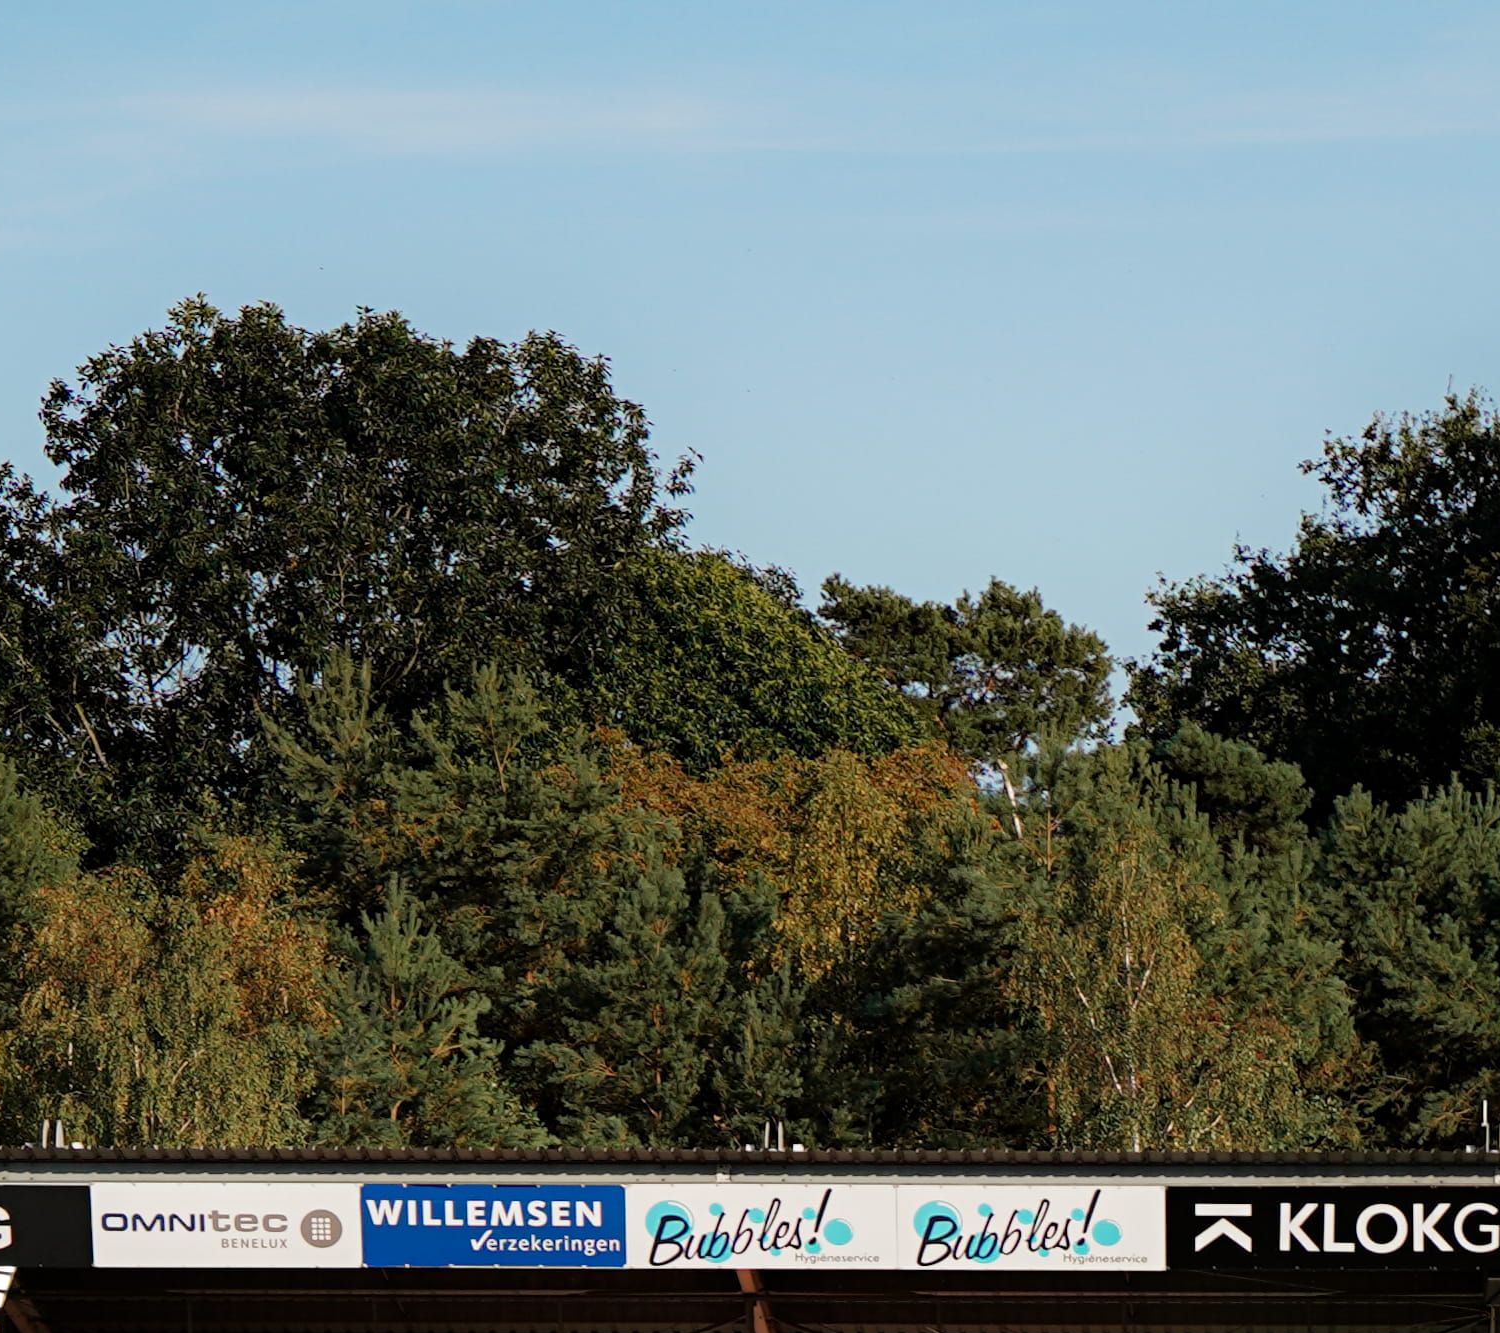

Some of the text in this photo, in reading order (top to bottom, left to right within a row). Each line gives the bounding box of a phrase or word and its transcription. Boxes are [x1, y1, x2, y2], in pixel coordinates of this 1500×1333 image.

[366, 1200, 601, 1226] WILLEMSEN
[649, 1188, 832, 1266] Bubbles!
[917, 1188, 1101, 1267] Bubbles!
[221, 1238, 287, 1248] BENELUX
